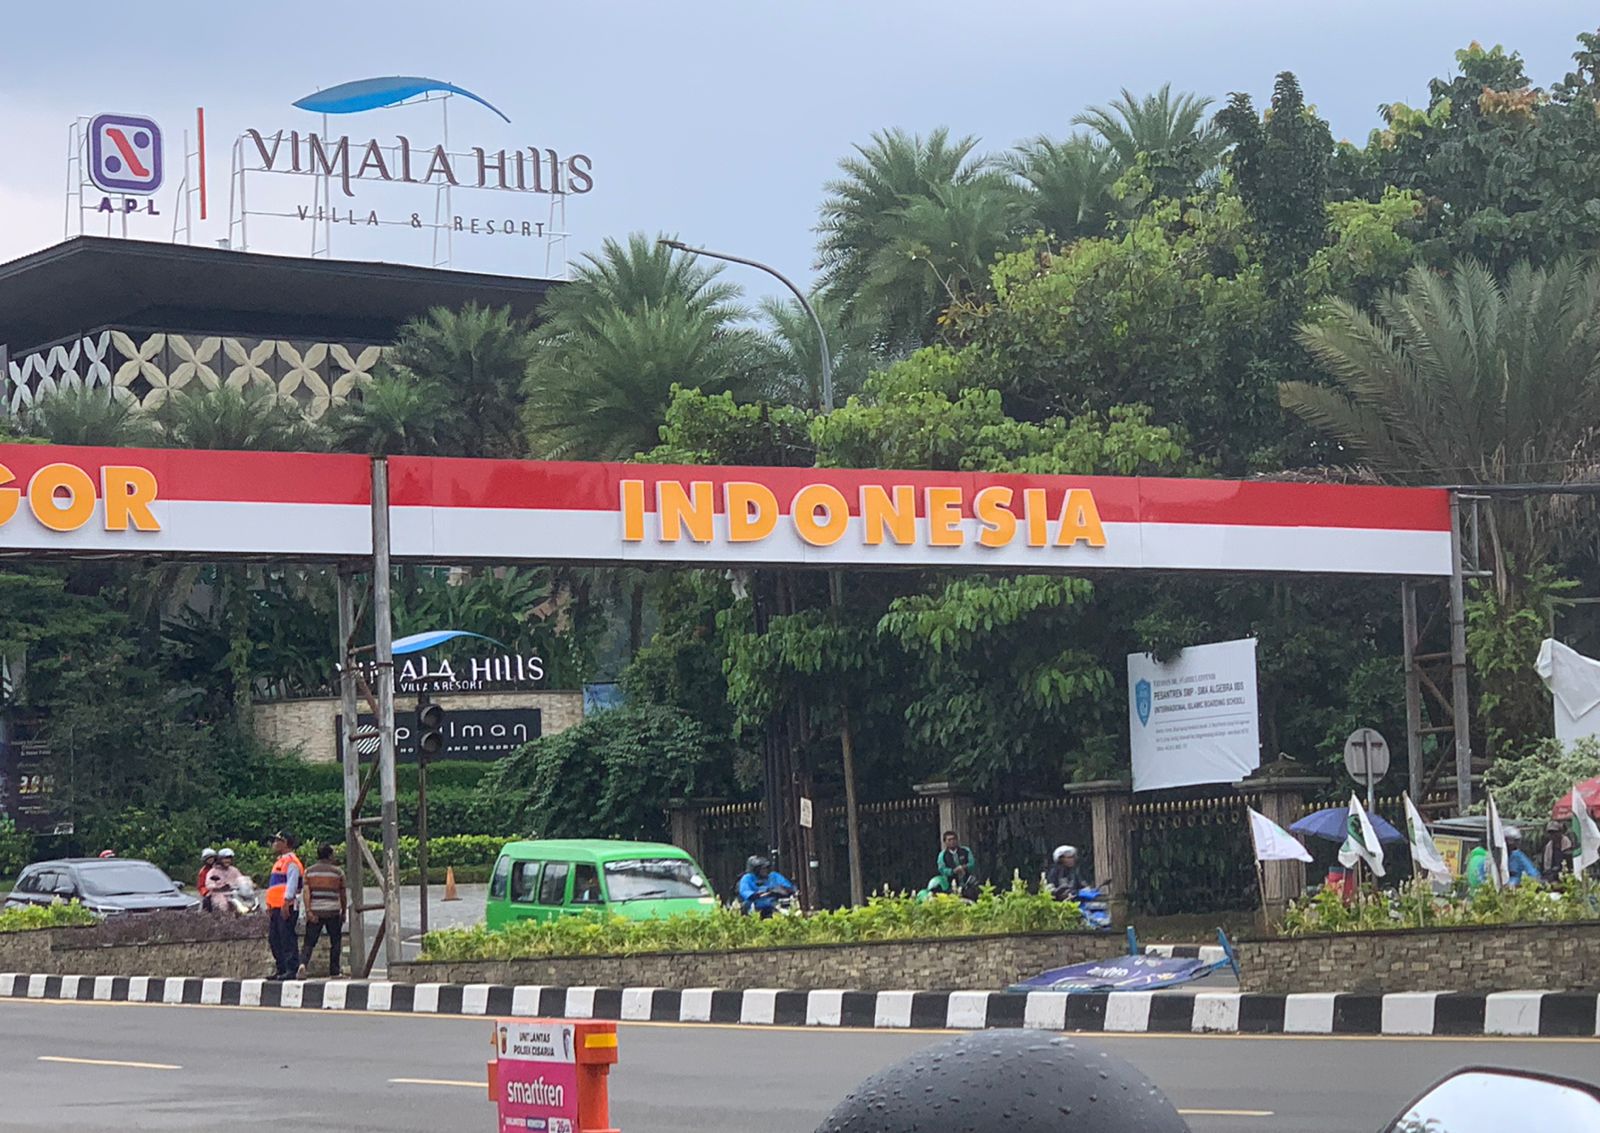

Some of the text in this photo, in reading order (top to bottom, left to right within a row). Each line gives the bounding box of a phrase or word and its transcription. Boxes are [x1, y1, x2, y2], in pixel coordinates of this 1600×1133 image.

[98, 195, 160, 215] APL
[297, 204, 545, 238] VILLA & RESORT
[620, 479, 1107, 547] INDONESIA
[442, 680, 483, 691] RESORT
[507, 1076, 564, 1107] smartfren
